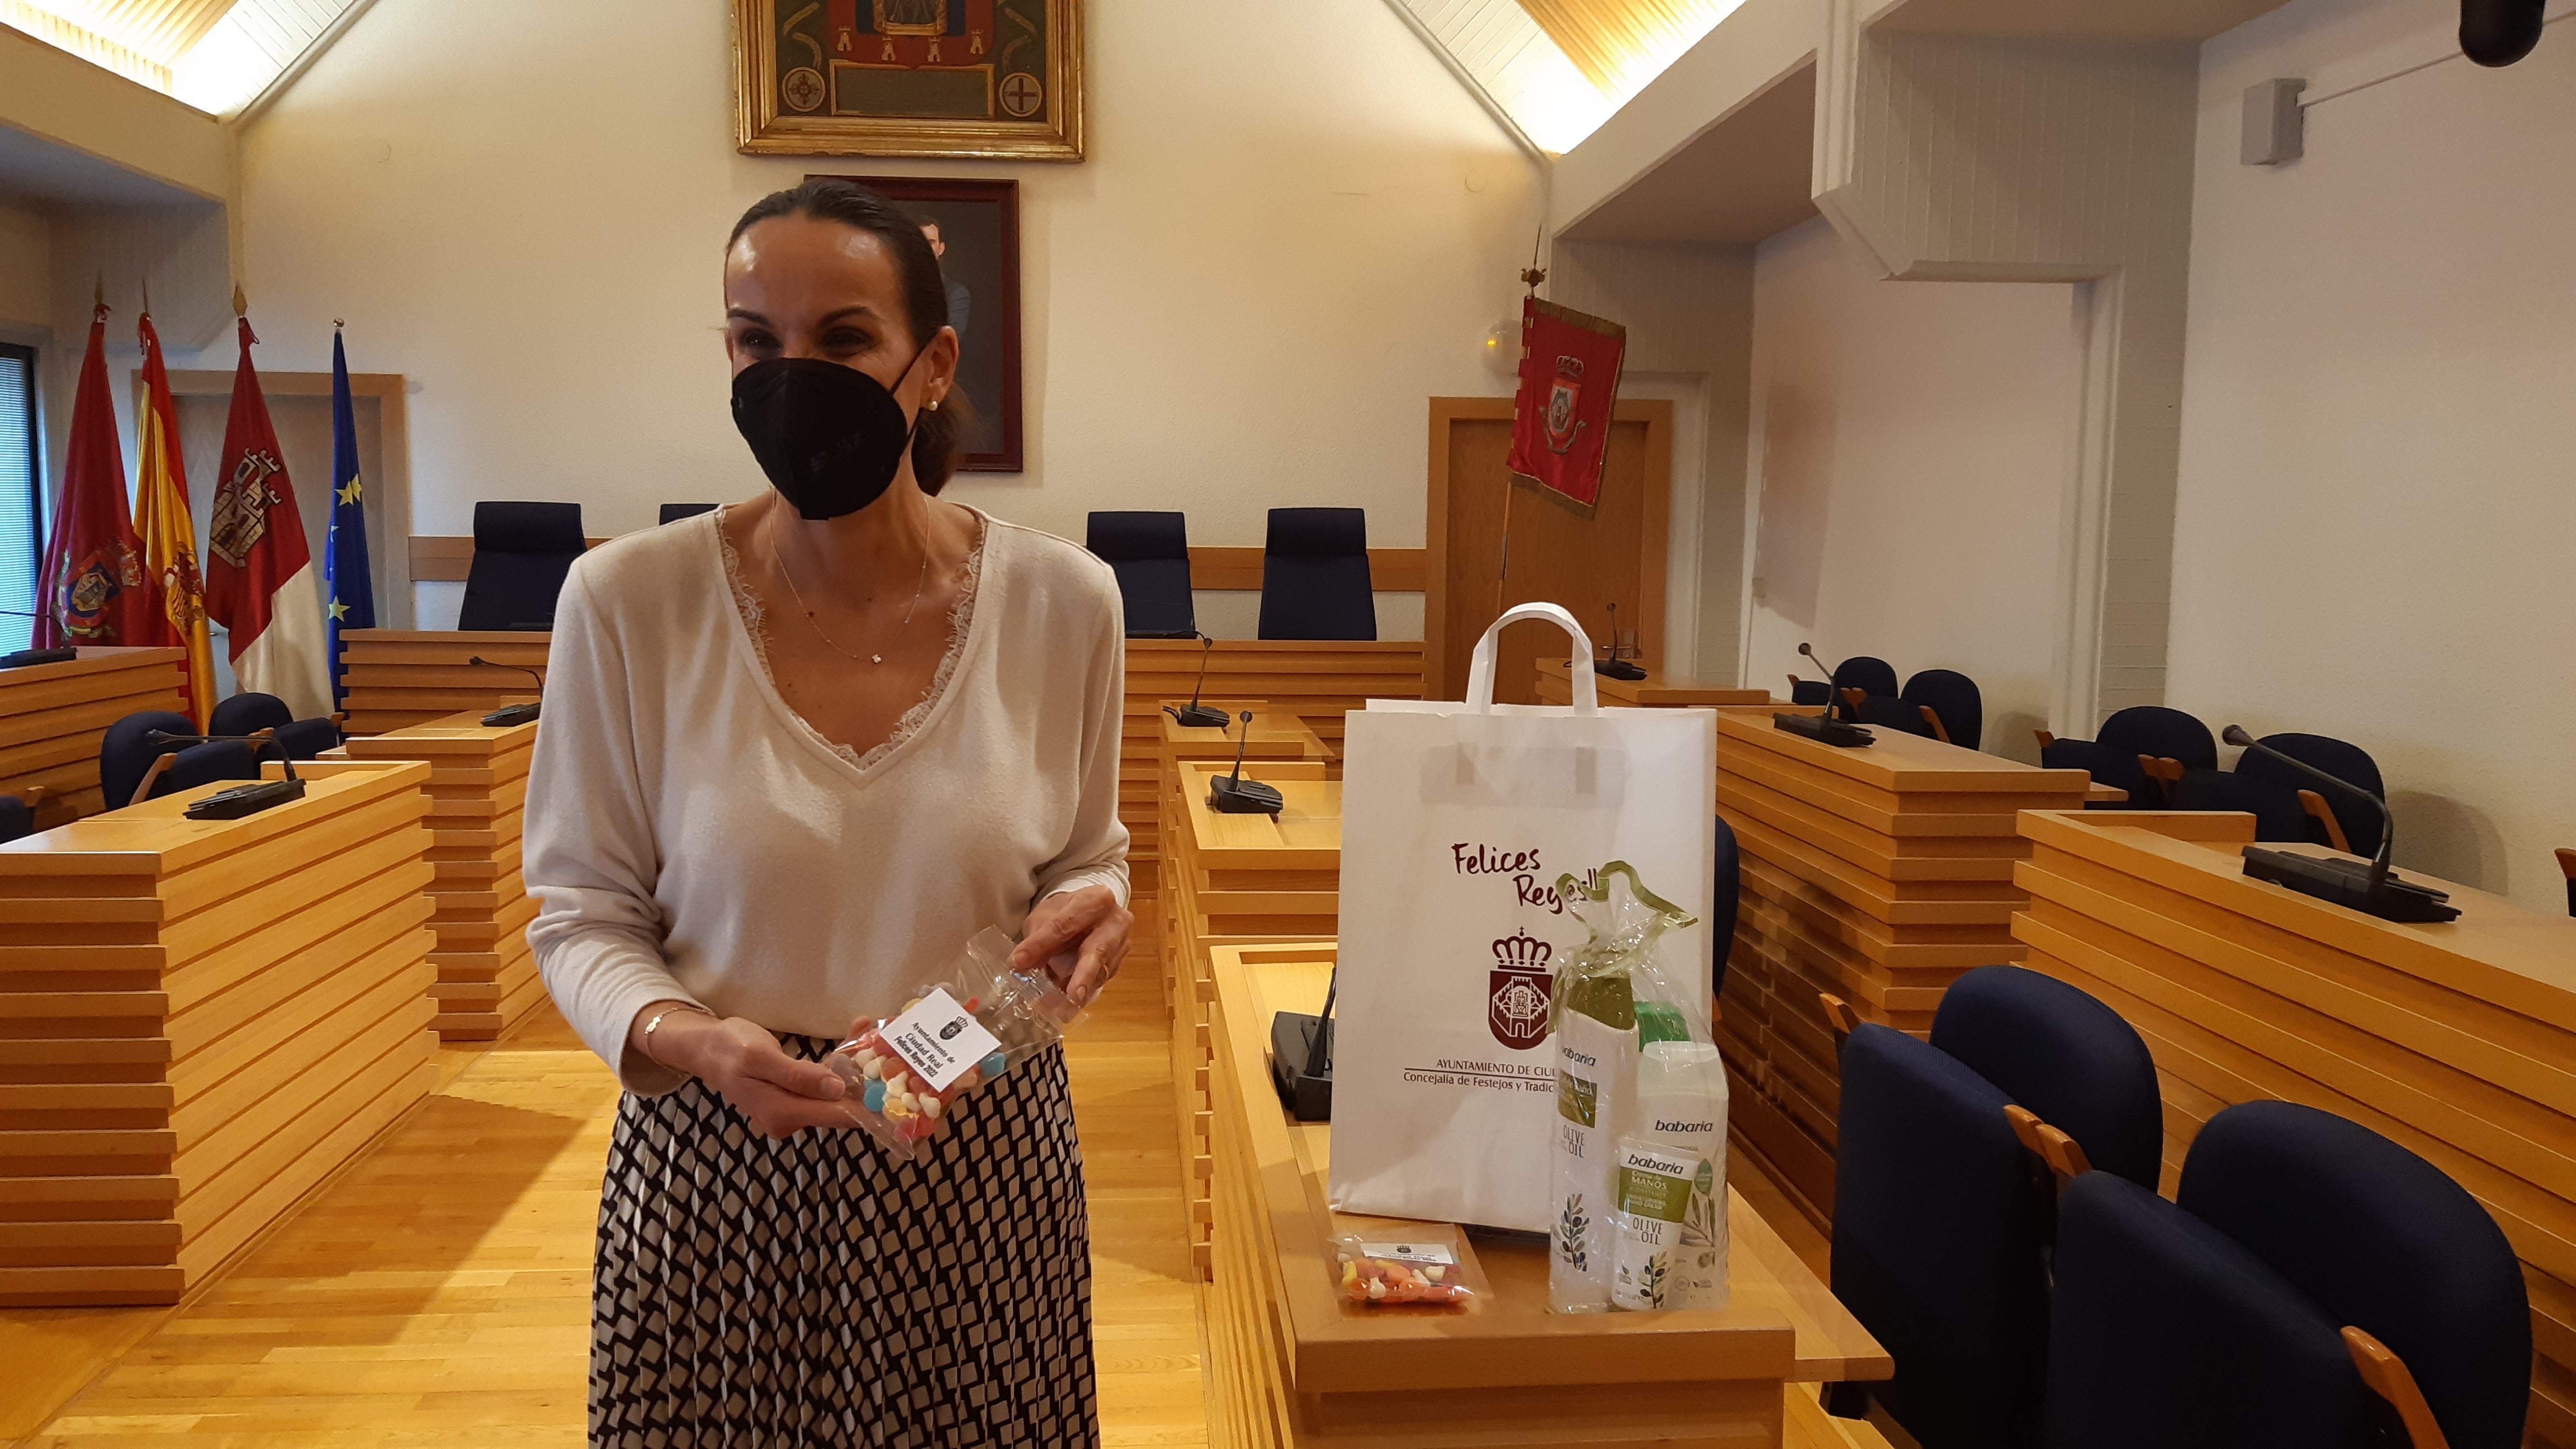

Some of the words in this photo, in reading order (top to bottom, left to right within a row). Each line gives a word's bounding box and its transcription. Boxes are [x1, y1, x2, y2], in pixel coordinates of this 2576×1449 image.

[1451, 842, 1541, 874] Felices
[912, 1022, 948, 1057] Ayuntamiento
[906, 1033, 930, 1055] Ciudad
[927, 1054, 944, 1069] Real
[1436, 1059, 1514, 1073] AYUNTAMIENTO
[1517, 1065, 1530, 1075] DE
[1534, 1067, 1555, 1077] CIU
[1404, 1072, 1454, 1085] Concejalía
[1457, 1074, 1470, 1086] de
[1473, 1077, 1513, 1090] Festejos
[1516, 1082, 1522, 1091] y
[1655, 1120, 1713, 1132] babaria
[1564, 1125, 1584, 1146] OLIVE
[1569, 1142, 1583, 1158] OIL
[1628, 1154, 1684, 1175] babaria
[1631, 1176, 1667, 1190] MANOS
[1633, 1218, 1663, 1235] OLIVE
[1641, 1232, 1660, 1245] OIL
